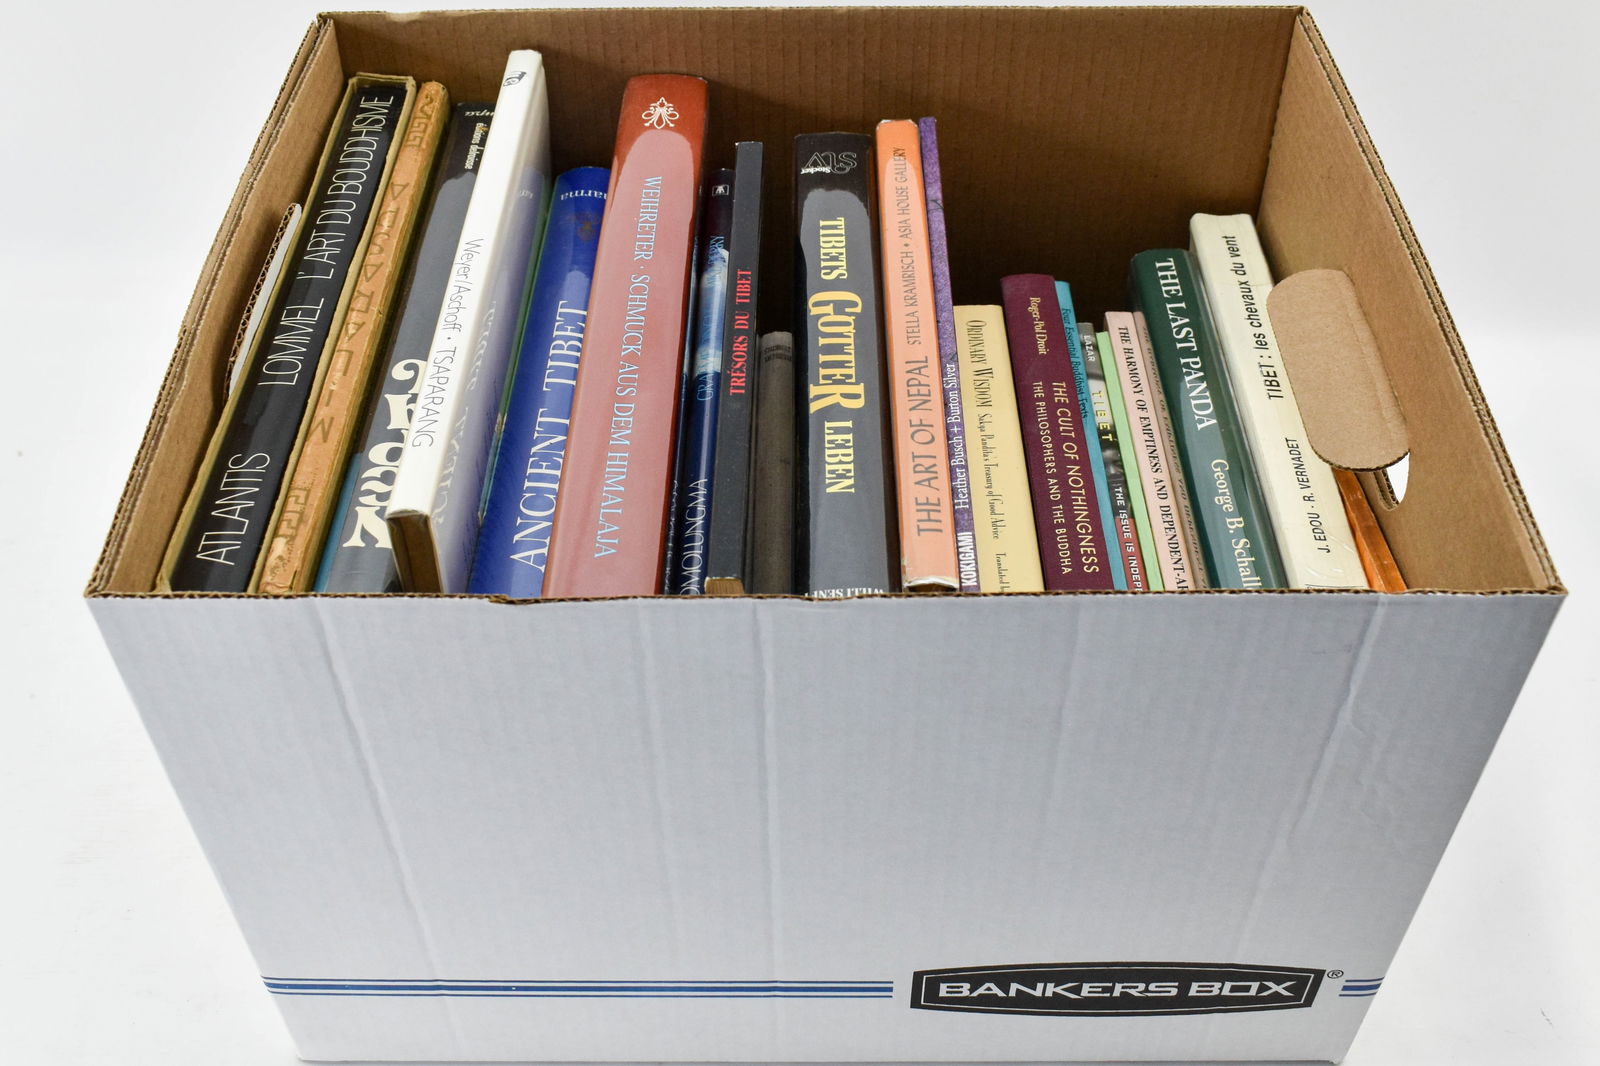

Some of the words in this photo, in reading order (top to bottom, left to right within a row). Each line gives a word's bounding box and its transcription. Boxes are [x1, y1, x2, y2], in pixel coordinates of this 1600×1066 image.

[327, 95, 394, 195] BOUDDHISME
[893, 147, 909, 183] GALLERY
[316, 200, 355, 224] DU
[633, 176, 663, 261] WEIHRETER
[896, 185, 911, 216] HOUSE
[898, 217, 914, 241] ASIA
[1222, 235, 1240, 257] vent
[297, 228, 345, 280] L'ART
[819, 217, 848, 280] TIBETS
[440, 238, 485, 336] Weyer/Aschoff
[736, 268, 752, 305] TIBET
[901, 251, 919, 307] KRAMRISCH
[1155, 257, 1183, 298] THE
[1230, 262, 1247, 276] du
[621, 273, 650, 357] SCHMUCK
[734, 311, 750, 329] DU
[1028, 297, 1045, 334] Roger-Pol
[1239, 280, 1263, 328] chevaux
[257, 297, 325, 386] LOMMEL
[907, 311, 921, 345] STELLA
[966, 319, 987, 364] ORDINARY
[1035, 334, 1049, 355] Droit
[1118, 326, 1132, 345] THE
[1166, 301, 1198, 352] LAST
[1253, 332, 1269, 350] les
[729, 335, 749, 396] TRÉSORS
[1083, 335, 1096, 362] LAZAR
[616, 361, 640, 396] AUS
[905, 356, 932, 412] NEPAL
[943, 363, 956, 389] Silver
[973, 367, 994, 408] WISDOM
[1033, 381, 1044, 398] THE
[1123, 347, 1145, 397] HARMONY
[1258, 361, 1284, 400] TIBET
[411, 346, 456, 449] TSAPARANG
[947, 390, 962, 424] Burton
[1052, 381, 1069, 404] THE
[1135, 399, 1149, 411] OF
[1180, 356, 1218, 431] PANDA
[609, 402, 635, 446] DEM
[909, 418, 936, 446] OF
[977, 413, 993, 432] Sakya
[1056, 408, 1075, 438] CULT
[1092, 390, 1113, 442] TIBET
[510, 408, 570, 573] ANCIENT
[542, 300, 588, 392] TIBET
[948, 436, 966, 466] Busch
[1036, 402, 1057, 474] PHILOSOPHERS
[1063, 443, 1079, 460] OF
[1139, 415, 1162, 474] EMPTINESS
[824, 420, 855, 493] LEBEN
[911, 452, 939, 491] ART
[1285, 437, 1312, 490] VERNADET
[952, 467, 969, 509] Heather
[983, 463, 998, 489] Treasury
[1047, 478, 1061, 501] AND
[1154, 477, 1169, 500] AND
[1211, 459, 1235, 513] George
[196, 452, 270, 565] ATLANTIS
[594, 452, 629, 558] HIMALAJA
[989, 498, 1004, 515] Good
[1114, 487, 1125, 506] THE
[1303, 492, 1315, 502] R.
[915, 497, 943, 536] THE
[991, 517, 1006, 540] Advice
[1052, 506, 1065, 524] THE
[1066, 465, 1100, 573] NOTHINGNESS
[1119, 510, 1132, 539] ISSUE
[1225, 516, 1245, 534] B.
[1307, 512, 1327, 542] EDOU
[957, 532, 978, 586] KOKIGAMI
[1055, 528, 1072, 574] BUDDHA
[1125, 543, 1135, 553] IS
[1231, 538, 1262, 589] Schall
[1318, 544, 1331, 554] J.
[995, 552, 1010, 584] Translated
[938, 981, 1178, 999] BANKERS
[1187, 981, 1297, 998] BOX
